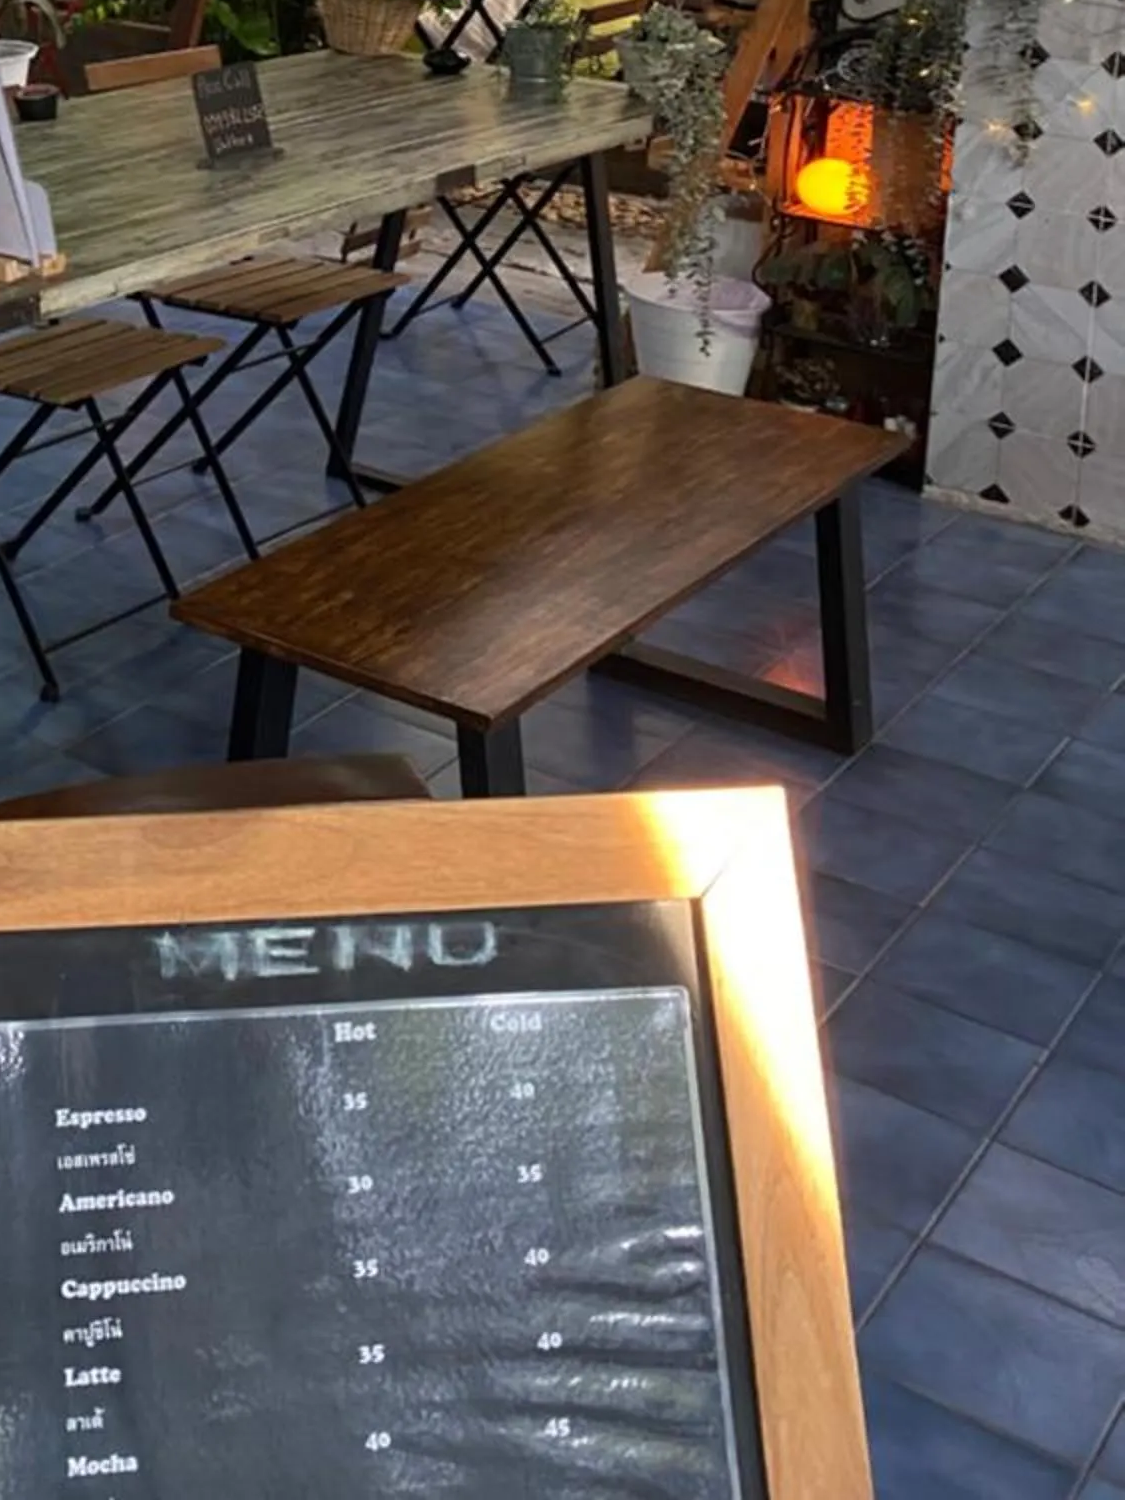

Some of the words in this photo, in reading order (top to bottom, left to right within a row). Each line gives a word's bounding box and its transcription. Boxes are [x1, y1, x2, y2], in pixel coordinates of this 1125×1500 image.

[149, 921, 498, 982] MENU
[334, 1021, 378, 1043] Hot
[490, 1011, 543, 1033] Cold
[55, 1105, 148, 1130] Espresso
[343, 1091, 368, 1111] 35
[58, 1187, 175, 1214] Americano
[348, 1175, 374, 1194] 30
[517, 1163, 543, 1183] 35
[61, 1271, 187, 1302] Cappuccino
[353, 1258, 379, 1278] 35
[524, 1247, 550, 1266] 40
[63, 1365, 123, 1388] Latte
[359, 1344, 386, 1364] 35
[537, 1331, 563, 1350] 40
[67, 1453, 139, 1479] Mocha
[365, 1431, 392, 1451] 40
[543, 1417, 571, 1438] 45
